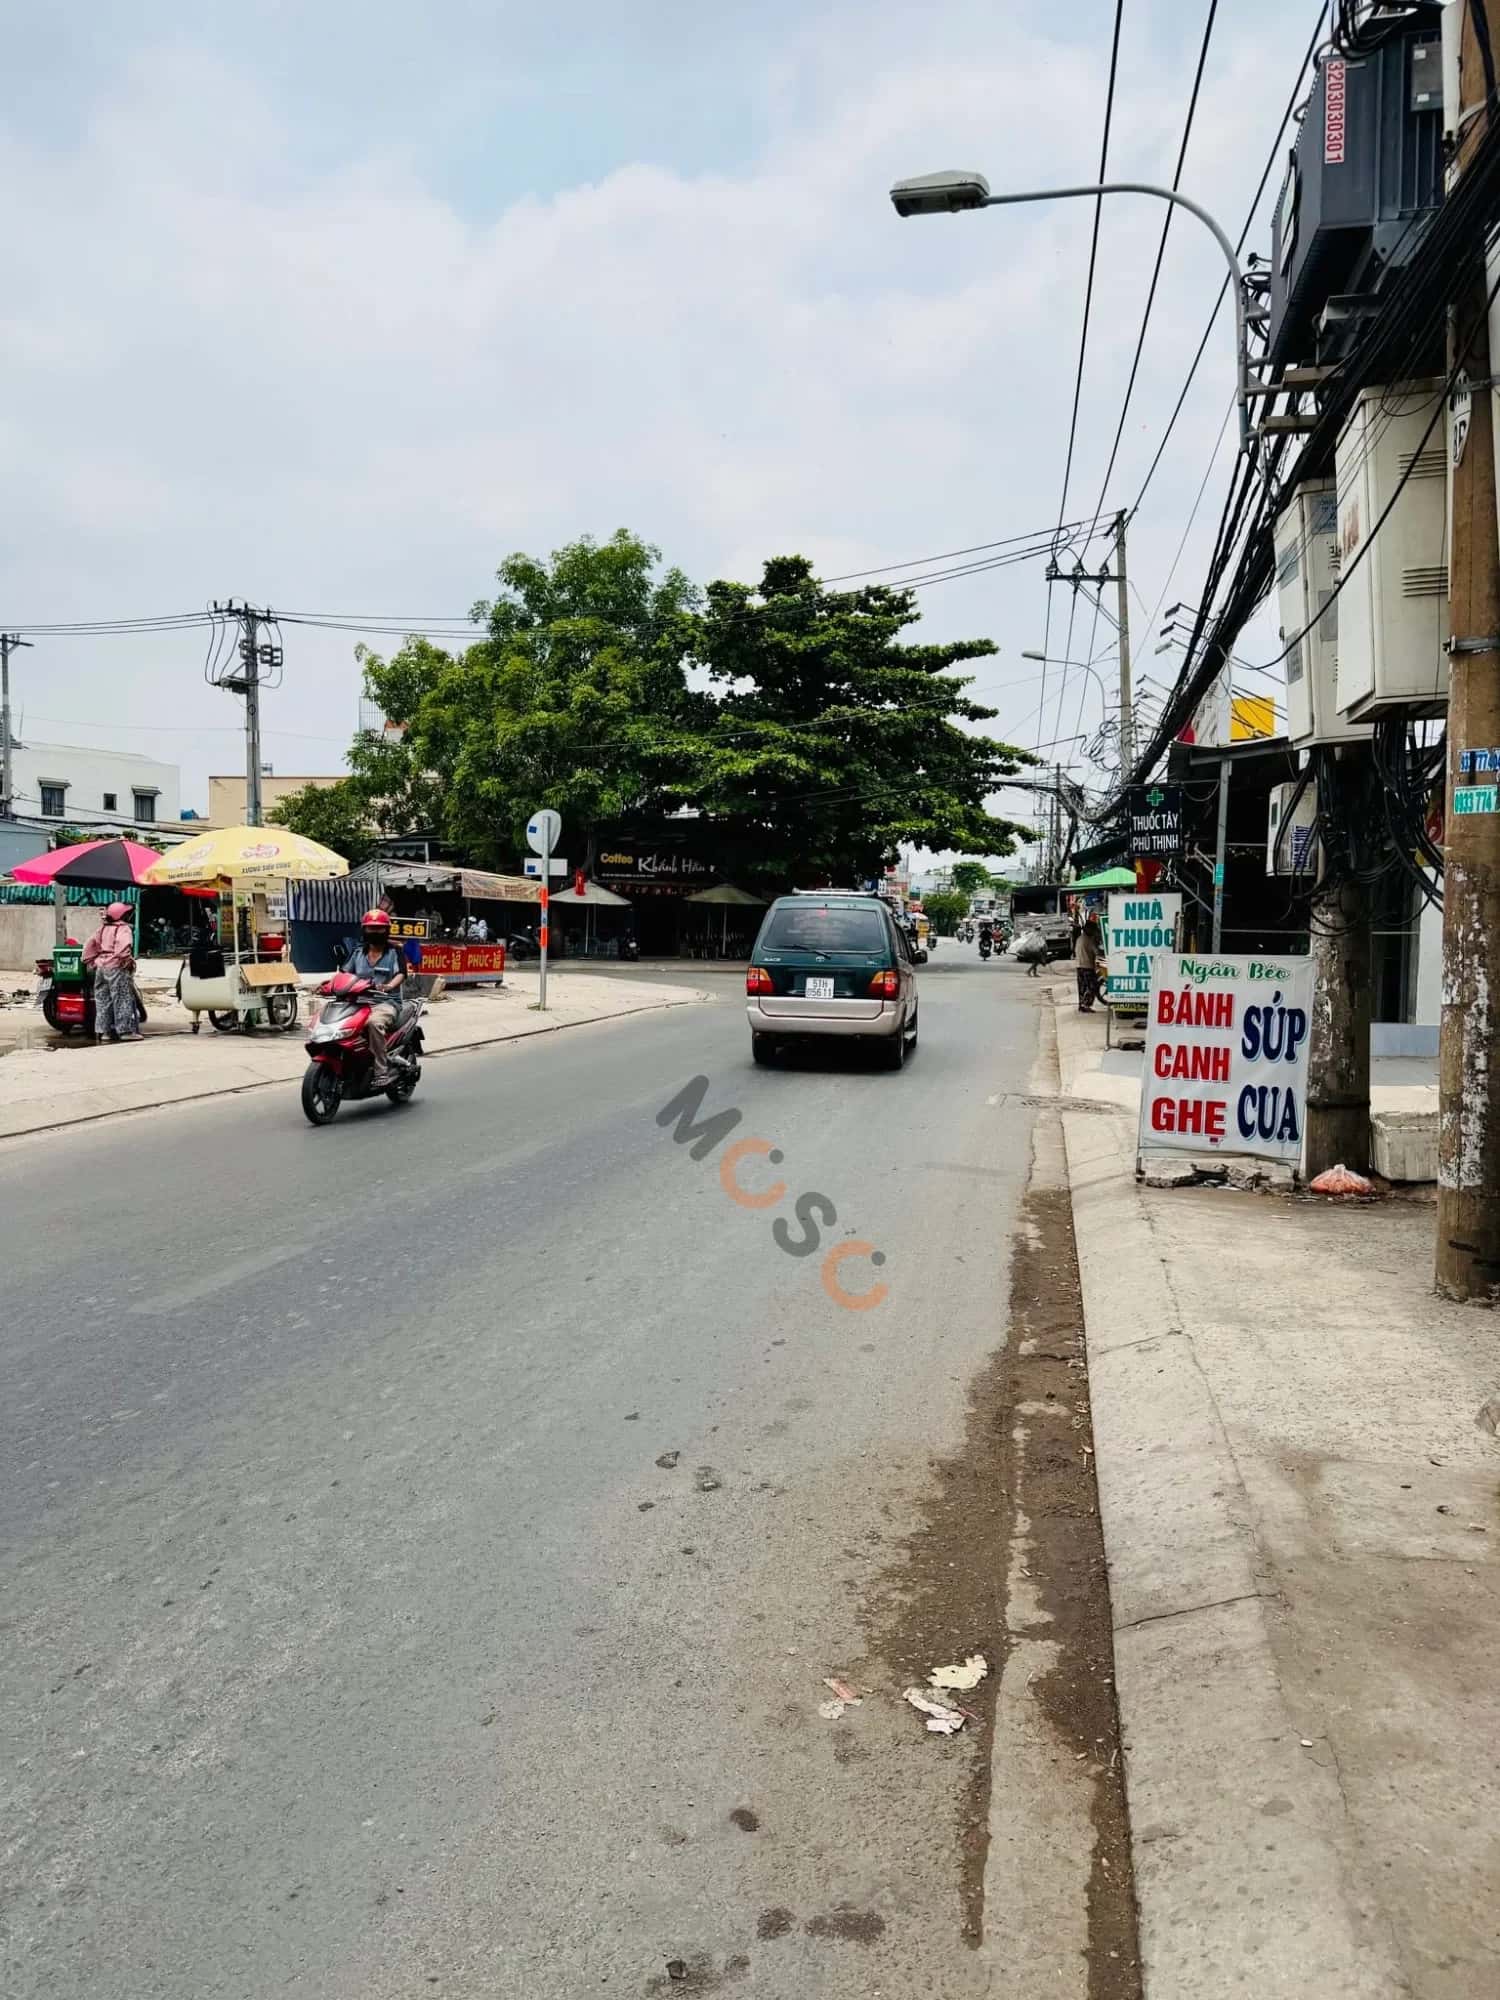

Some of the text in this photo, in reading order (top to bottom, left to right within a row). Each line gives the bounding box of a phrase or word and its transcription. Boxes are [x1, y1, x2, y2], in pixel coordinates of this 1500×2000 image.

[1327, 62, 1344, 162] 3203030301
[1132, 809, 1179, 831] THUỐC TÂY
[1152, 833, 1179, 852] THỊNH
[1124, 898, 1163, 921] NHÀ
[1112, 922, 1175, 947] THUỐC
[1126, 952, 1153, 974] TÂ
[1181, 959, 1290, 983] Ngân Béo
[1157, 984, 1234, 1028] BÁNH
[1241, 990, 1307, 1063] SÚP
[1154, 1043, 1231, 1082] CANH
[1151, 1096, 1227, 1144] GHẸ
[1237, 1084, 1300, 1141] CUA
